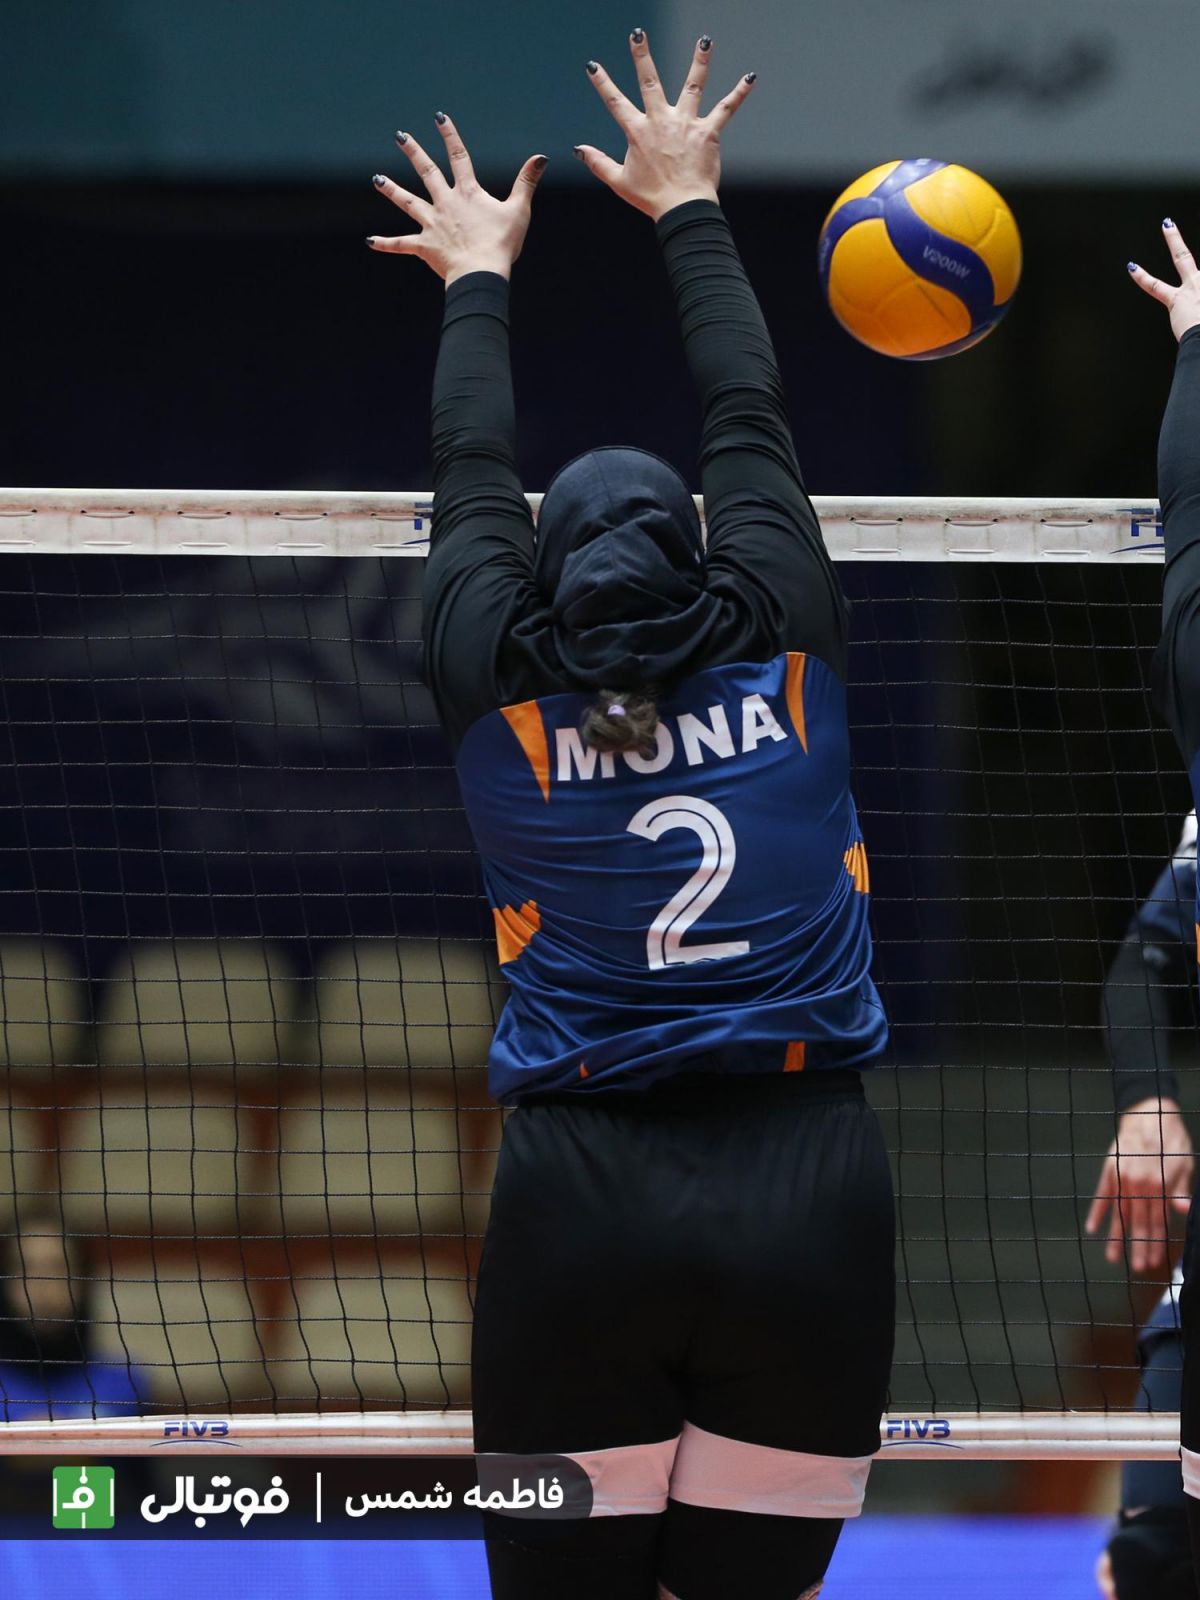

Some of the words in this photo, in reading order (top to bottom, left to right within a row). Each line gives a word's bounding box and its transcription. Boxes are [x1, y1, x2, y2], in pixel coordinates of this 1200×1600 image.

[922, 245, 970, 278] V200W
[555, 693, 788, 781] MONA
[626, 795, 750, 970] 2
[164, 1421, 229, 1437] FIVB
[887, 1419, 951, 1439] FIVB
